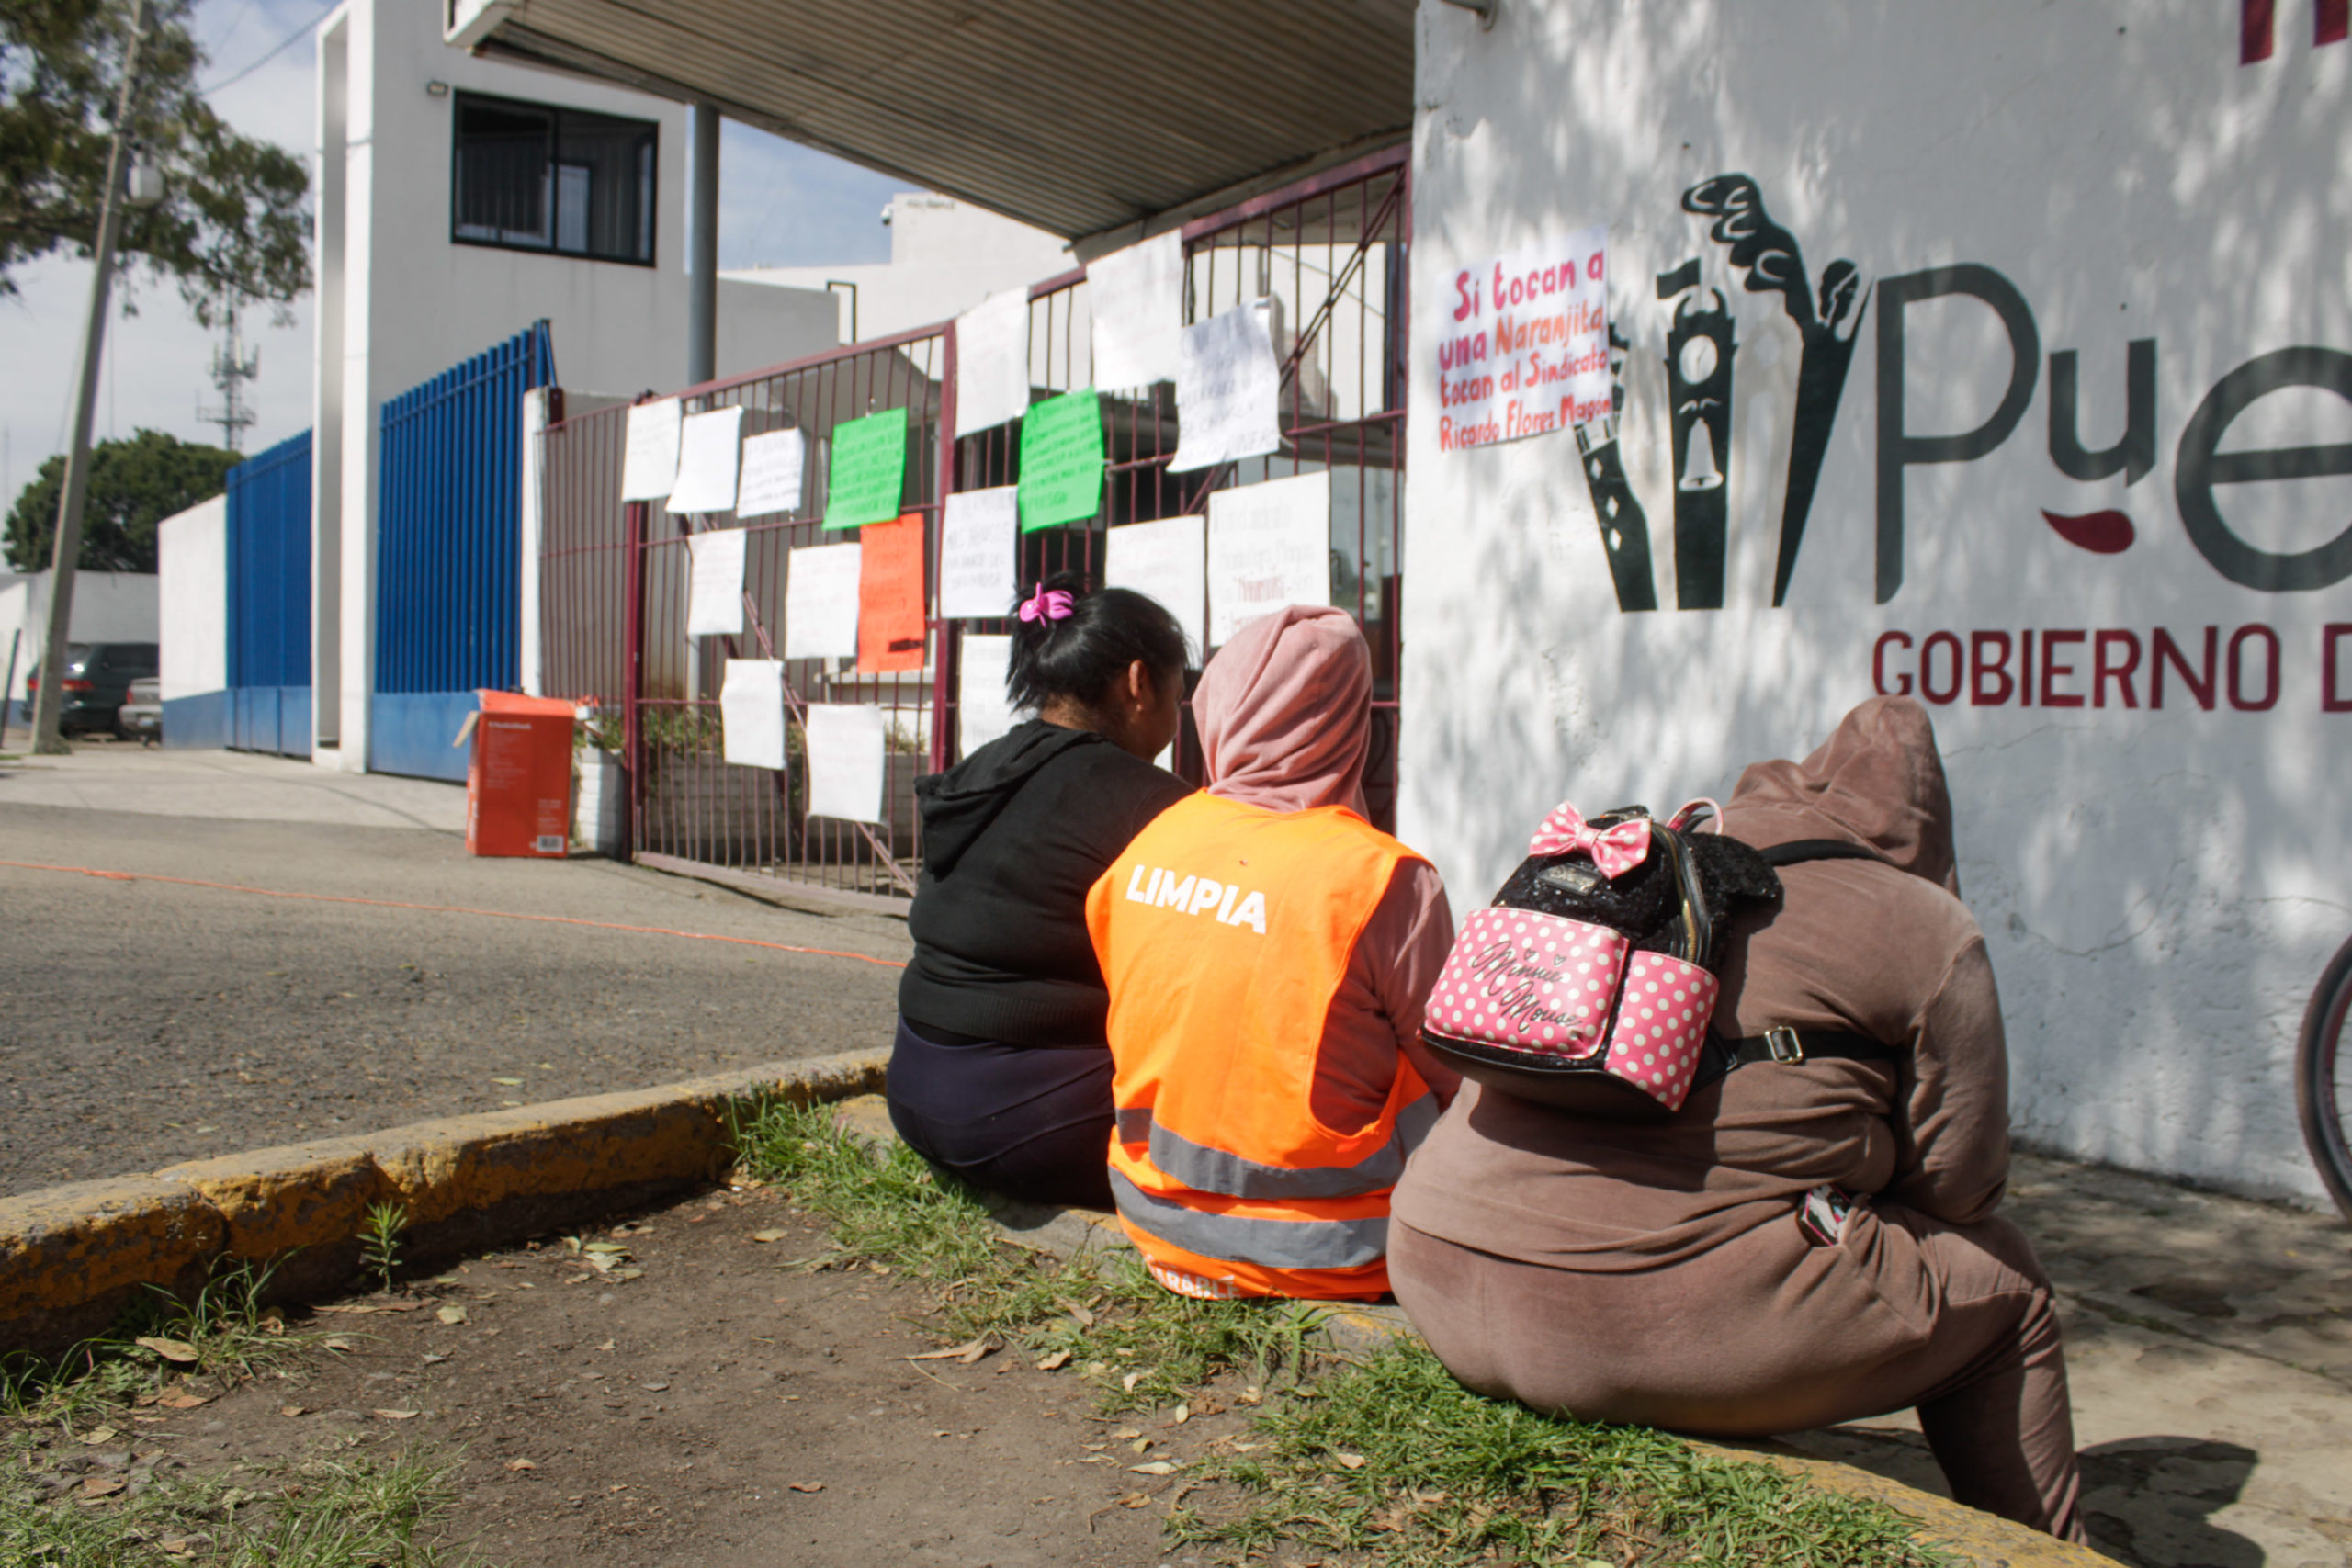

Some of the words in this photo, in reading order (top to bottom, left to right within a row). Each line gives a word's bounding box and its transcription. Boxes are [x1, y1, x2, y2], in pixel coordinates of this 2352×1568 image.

[1453, 270, 1480, 322] Si
[1493, 261, 1576, 310] tocan
[1587, 249, 1604, 281] a
[1439, 331, 1487, 371] una
[1440, 373, 1494, 409] tocan
[1500, 359, 1520, 392] al
[1525, 344, 1607, 388] Sindicato
[1440, 409, 1500, 453] Ricardo
[1506, 399, 1555, 439] Flores
[1872, 623, 2281, 712] GOBIERNO
[1125, 863, 1267, 935] LIMPIA
[1499, 981, 1582, 1032] Mouse
